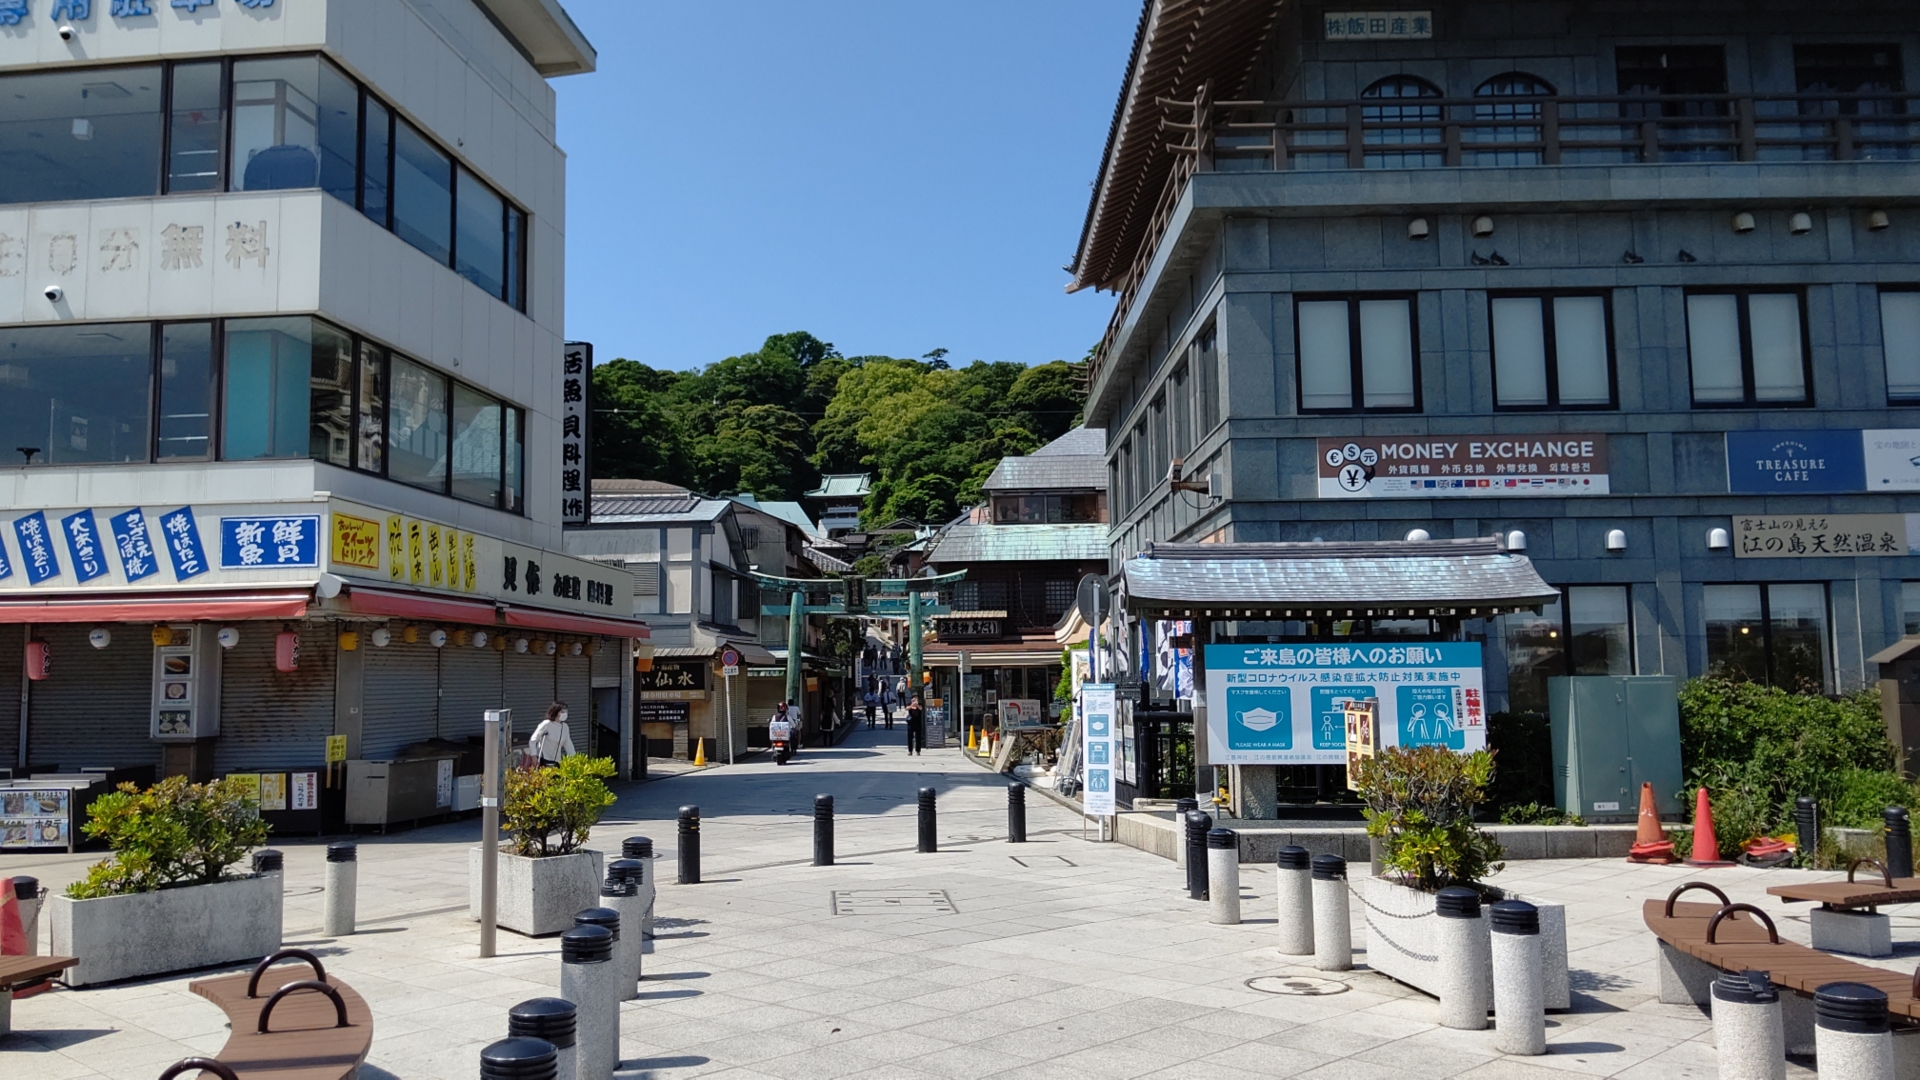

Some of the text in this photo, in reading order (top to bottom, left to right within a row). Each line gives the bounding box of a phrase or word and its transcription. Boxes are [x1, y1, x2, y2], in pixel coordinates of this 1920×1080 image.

[1381, 441, 1594, 460] MONEY EXCHANGE
[1388, 465, 1430, 475] 外貨両替
[1756, 459, 1826, 470] TREASURE
[1775, 471, 1809, 482] CAFE
[126, 513, 152, 558] さざえ
[235, 519, 304, 546] 新鮮
[1741, 518, 1829, 532] 富士山の見える
[20, 517, 50, 577] 焼はまぐり
[70, 516, 99, 577] 大あさり
[166, 513, 200, 574] 焼ほたて
[341, 531, 374, 549] スイーツ
[1743, 532, 1899, 554] 江の島天然温泉
[117, 534, 149, 577] つぼ焼
[239, 543, 301, 566] 魚貝
[341, 548, 376, 565] ドリンク
[411, 524, 423, 580] ラムネ
[428, 530, 443, 583] 缶ビール
[448, 533, 459, 586] 生ビール
[1242, 646, 1442, 666] ご来島の皆様へのお願い
[1226, 671, 1461, 683] 新型コロナウイルス感染症拡大防止対策実施中
[1465, 688, 1482, 726] 駐輪禁止
[34, 819, 62, 829] ホタテ
